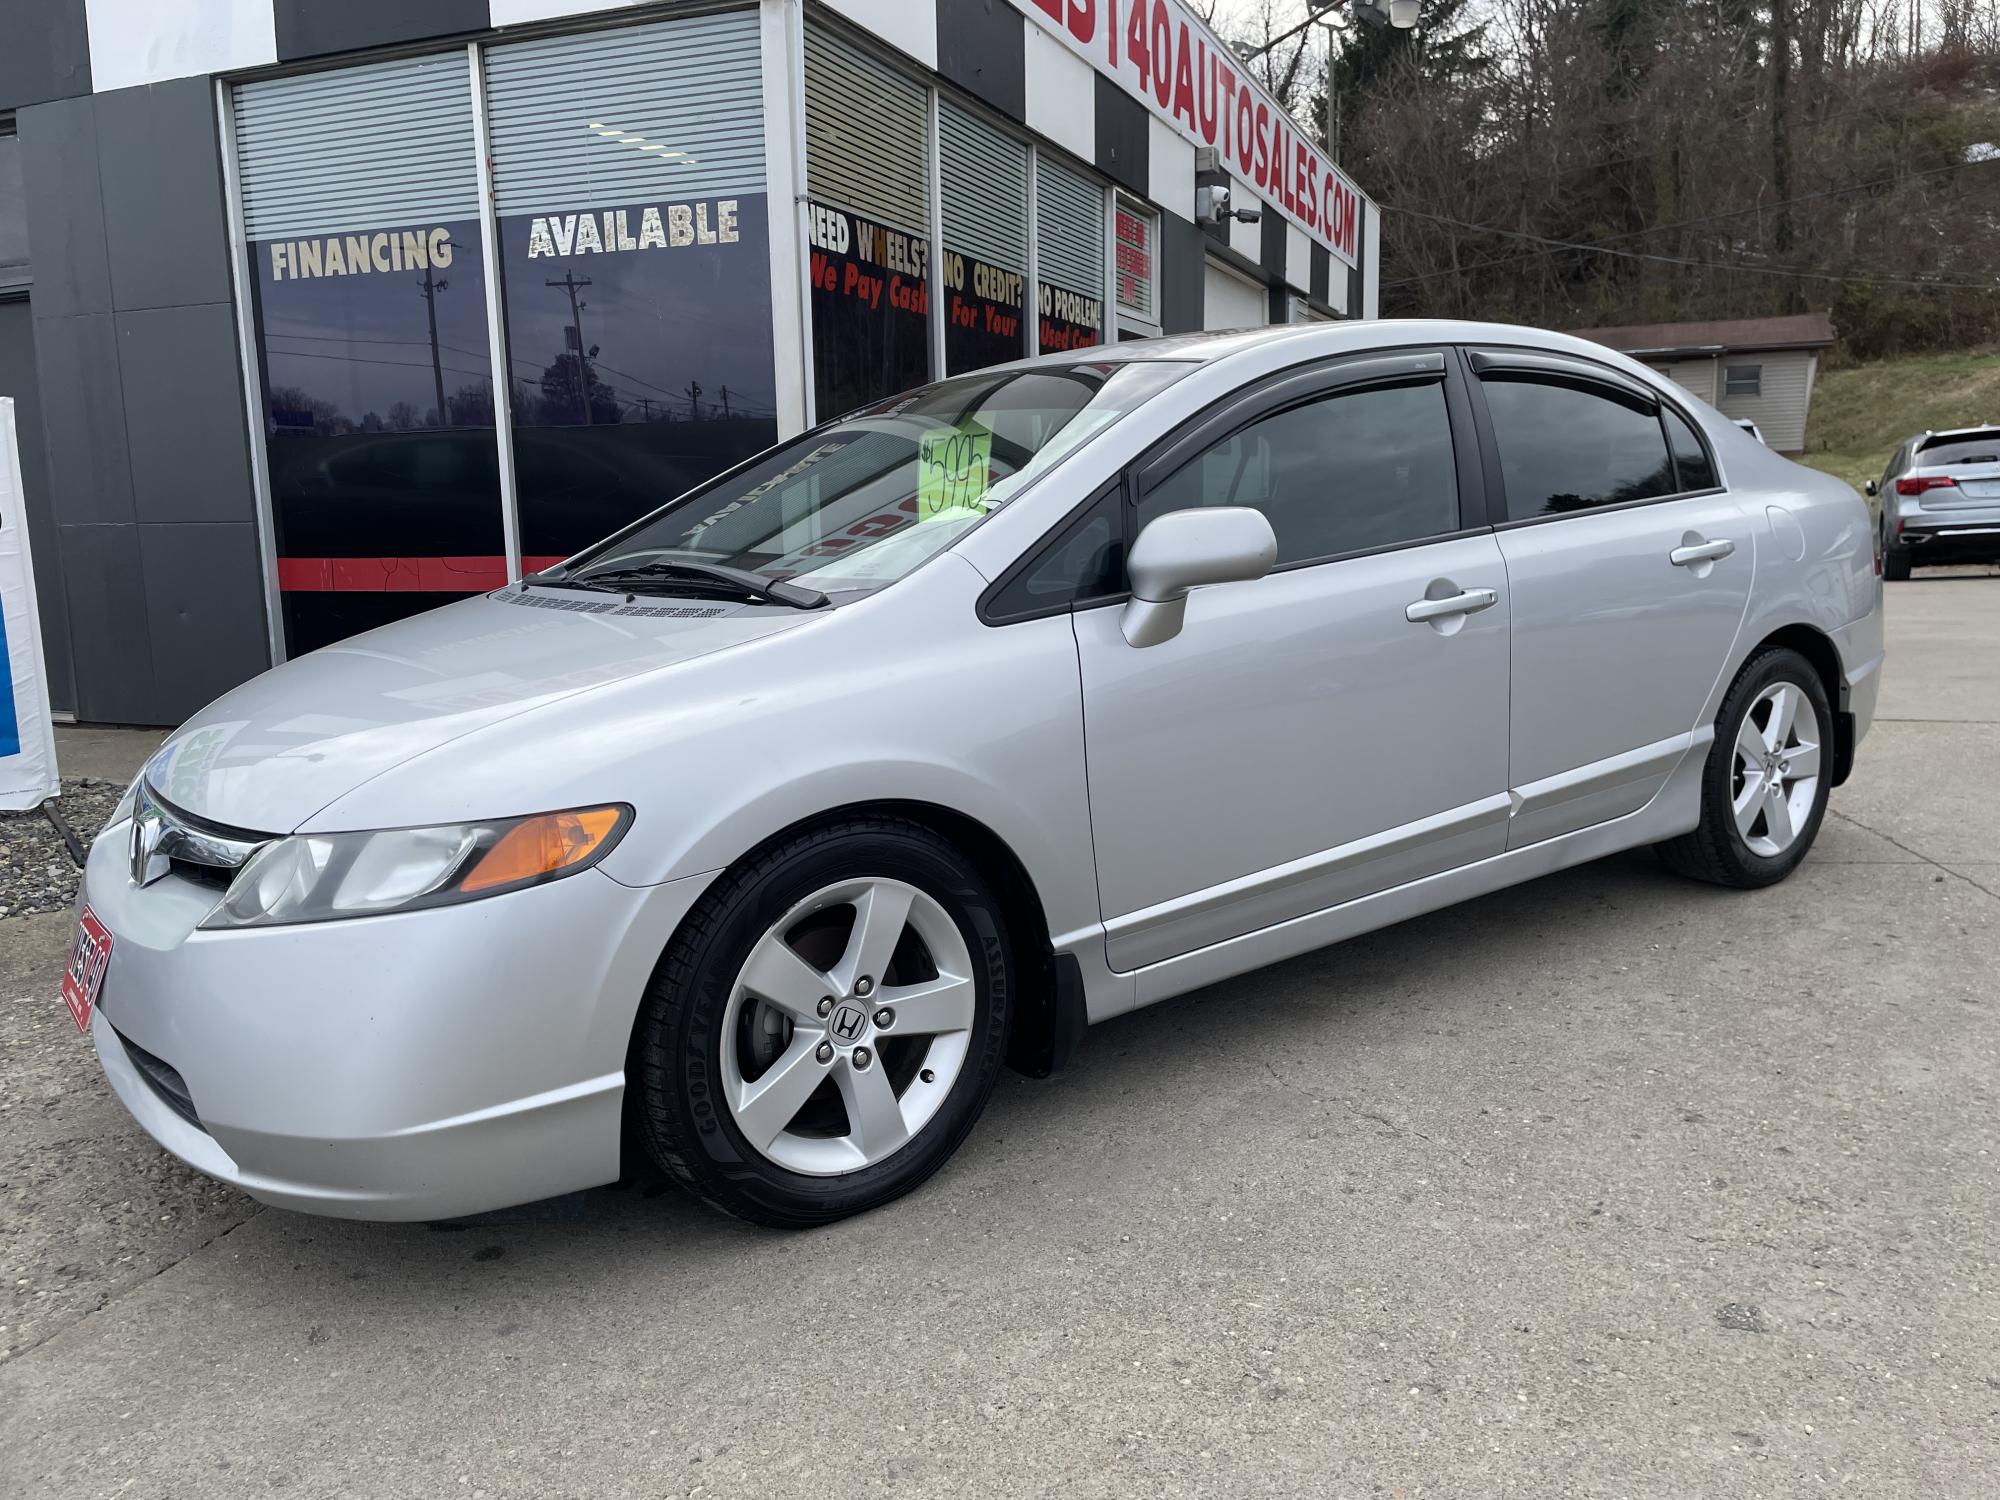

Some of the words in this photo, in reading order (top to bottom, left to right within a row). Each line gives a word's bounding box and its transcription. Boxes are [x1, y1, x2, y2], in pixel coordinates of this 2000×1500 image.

[1031, 0, 1356, 258] 40AUTOSALES.COM
[270, 227, 453, 281] FINANCING
[527, 200, 740, 259] AVAILABLE
[807, 203, 850, 255] NEED
[855, 219, 929, 280] WHEELS?
[943, 251, 965, 292] NO
[973, 262, 1023, 309] CREDIT?
[1037, 283, 1052, 317] NO
[810, 252, 837, 292] We
[844, 262, 883, 310] Pay
[890, 275, 928, 316] Cash
[952, 296, 978, 328] For
[985, 304, 1018, 338] Your
[921, 432, 989, 513] $5995
